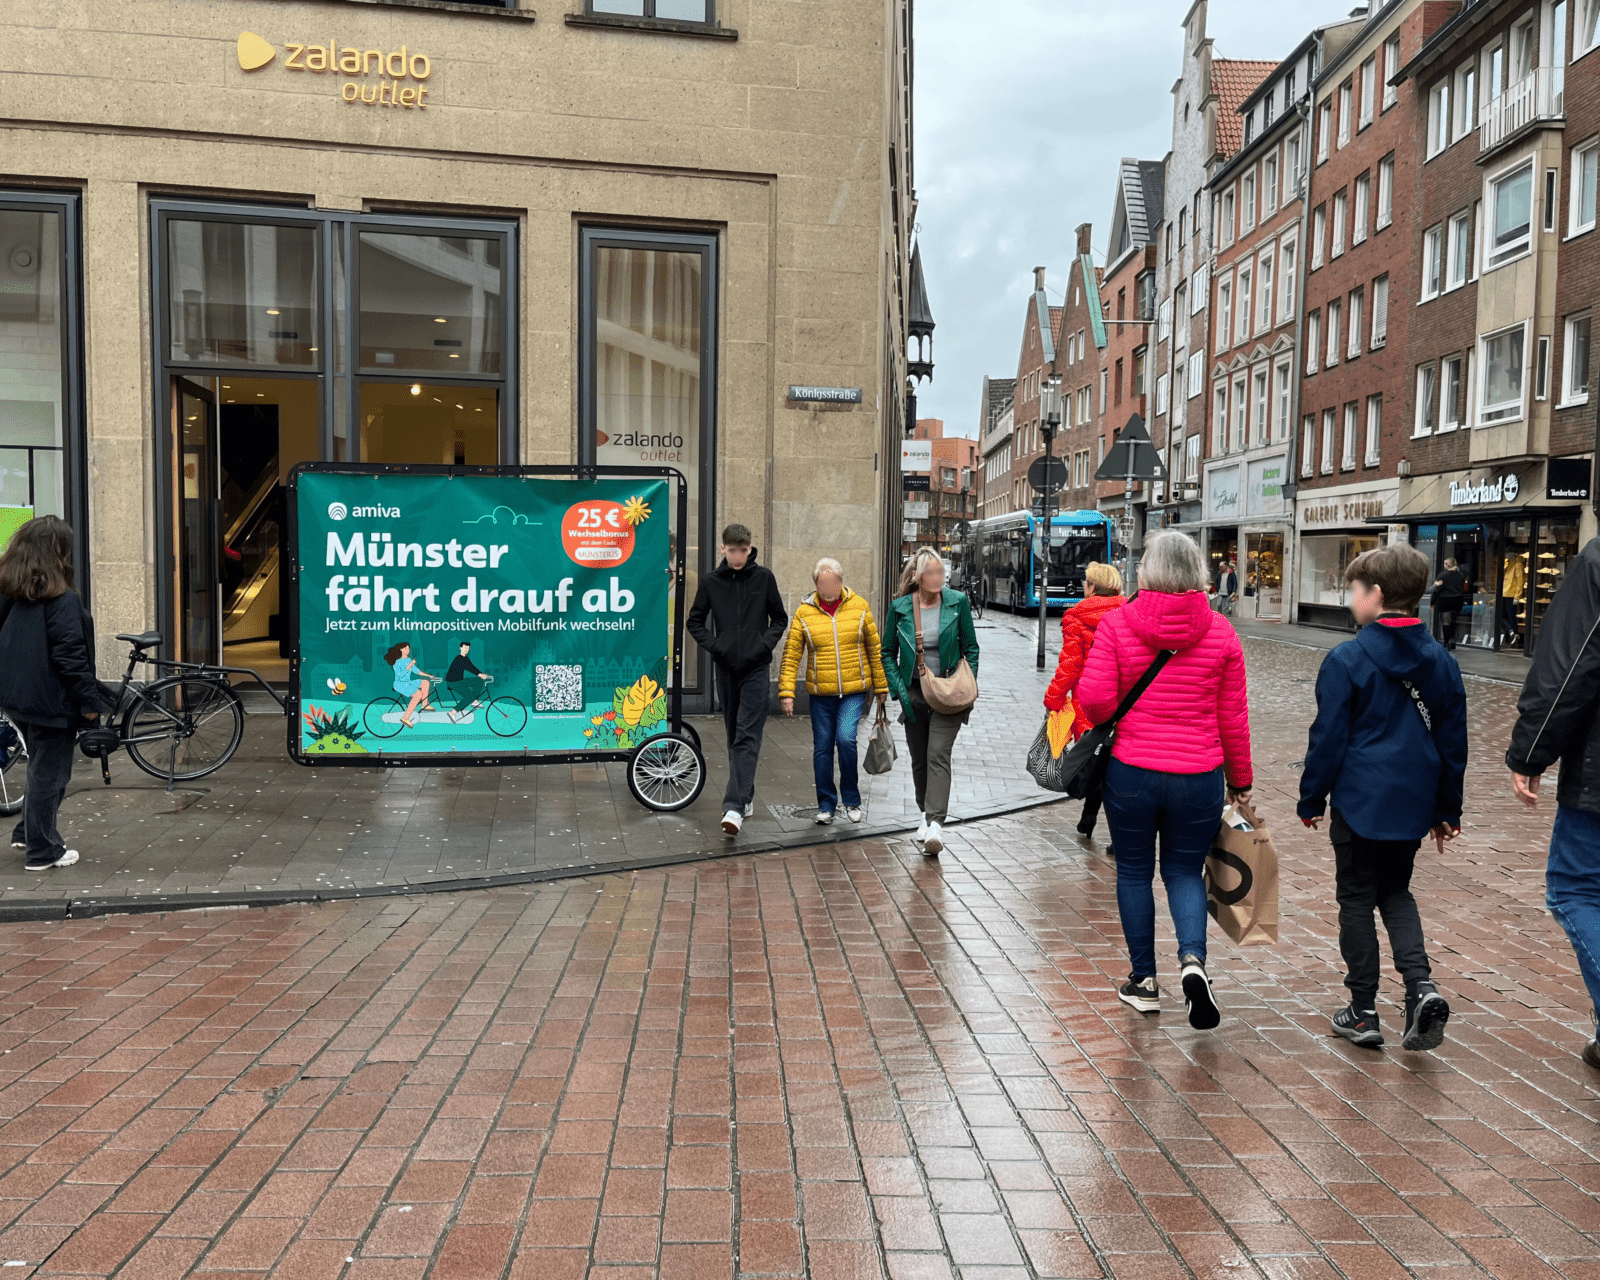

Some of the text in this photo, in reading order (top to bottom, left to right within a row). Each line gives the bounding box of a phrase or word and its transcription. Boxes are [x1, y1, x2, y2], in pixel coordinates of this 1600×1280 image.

[284, 38, 431, 80] zalando
[342, 80, 429, 108] outlet
[795, 387, 857, 400] Königsstraße
[613, 431, 684, 448] zalando
[640, 449, 682, 462] outlet
[1449, 475, 1503, 505] Timberland
[1550, 488, 1580, 497] Timberland
[352, 503, 401, 518] amiva
[577, 507, 620, 528] 25 €
[1304, 504, 1339, 524] GALERIE
[568, 529, 629, 538] Wechselbonus
[325, 531, 508, 568] Münster
[578, 549, 619, 558] MÜNSTER25
[325, 574, 635, 613] fährt drauf ab
[324, 617, 635, 634] Jetzt zum klimapositiven Mobilfunk wechseln!
